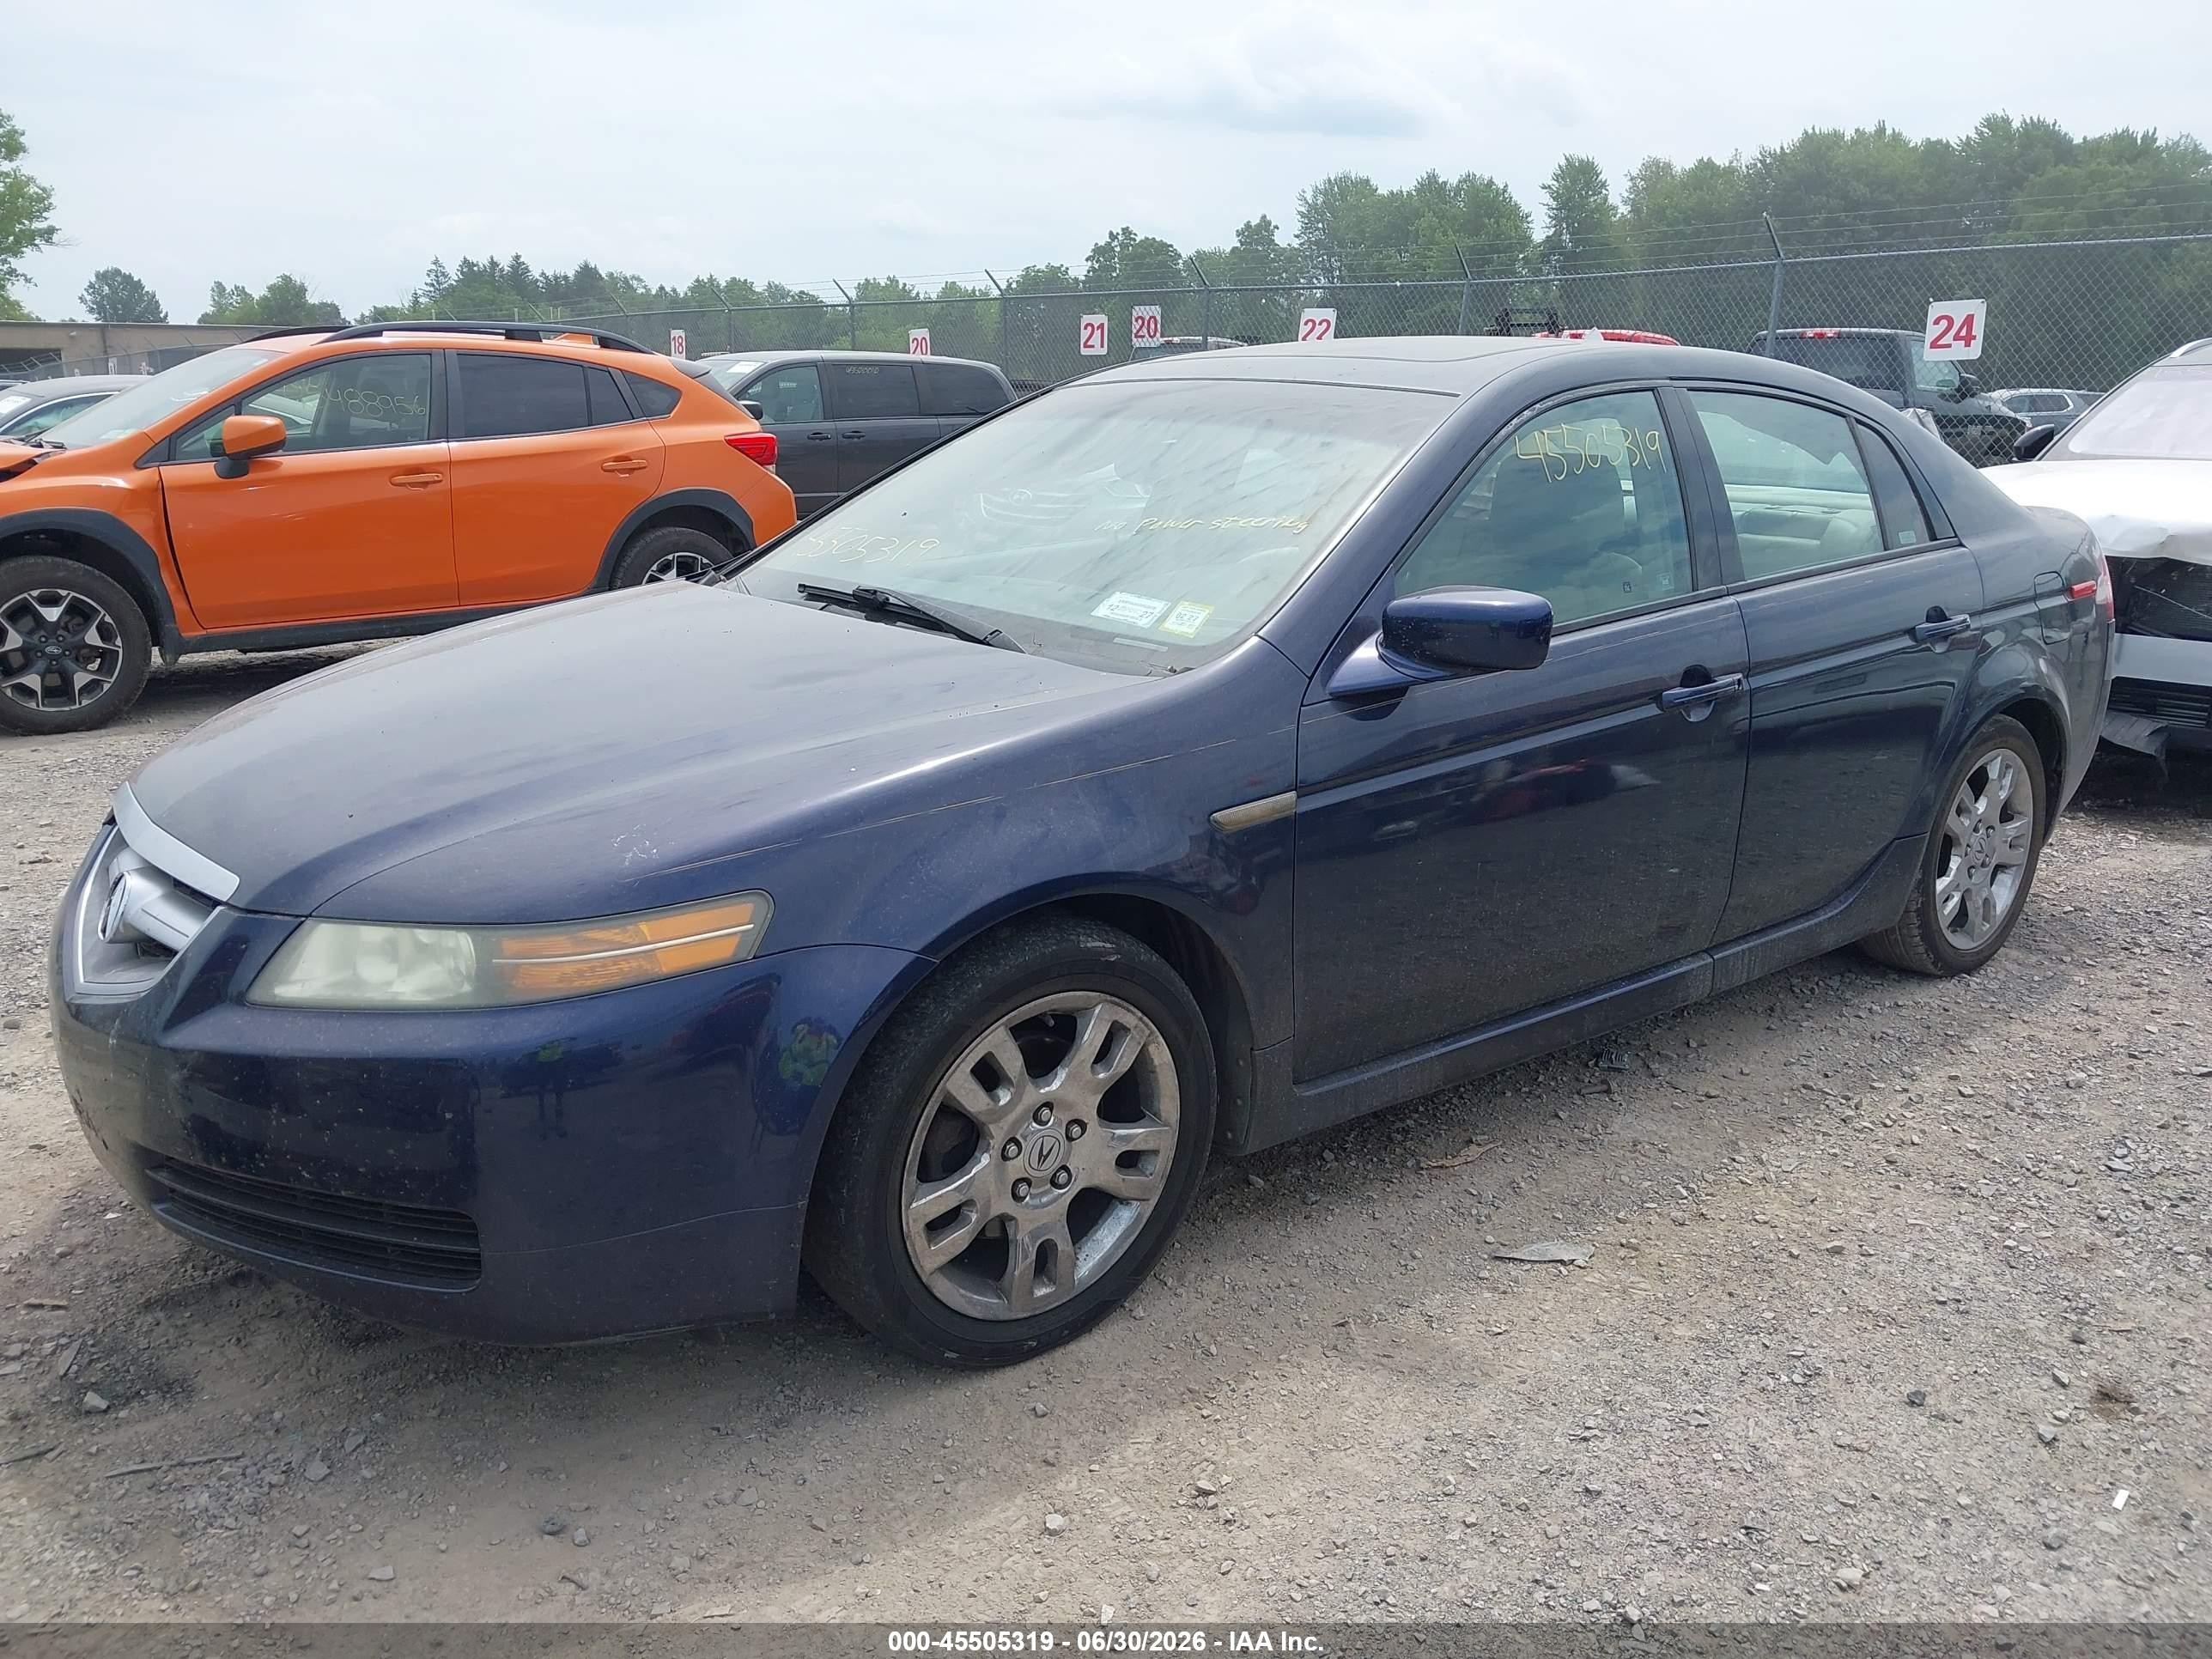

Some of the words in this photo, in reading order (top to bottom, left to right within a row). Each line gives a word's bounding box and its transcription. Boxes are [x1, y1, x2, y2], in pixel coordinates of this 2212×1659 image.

[1083, 322, 1105, 349] 21
[1134, 315, 1158, 339] 20
[1302, 318, 1331, 342] 22
[1929, 313, 1977, 350] 24
[672, 336, 684, 354] 18
[912, 337, 928, 356] 20
[1515, 422, 1668, 483] 45505319
